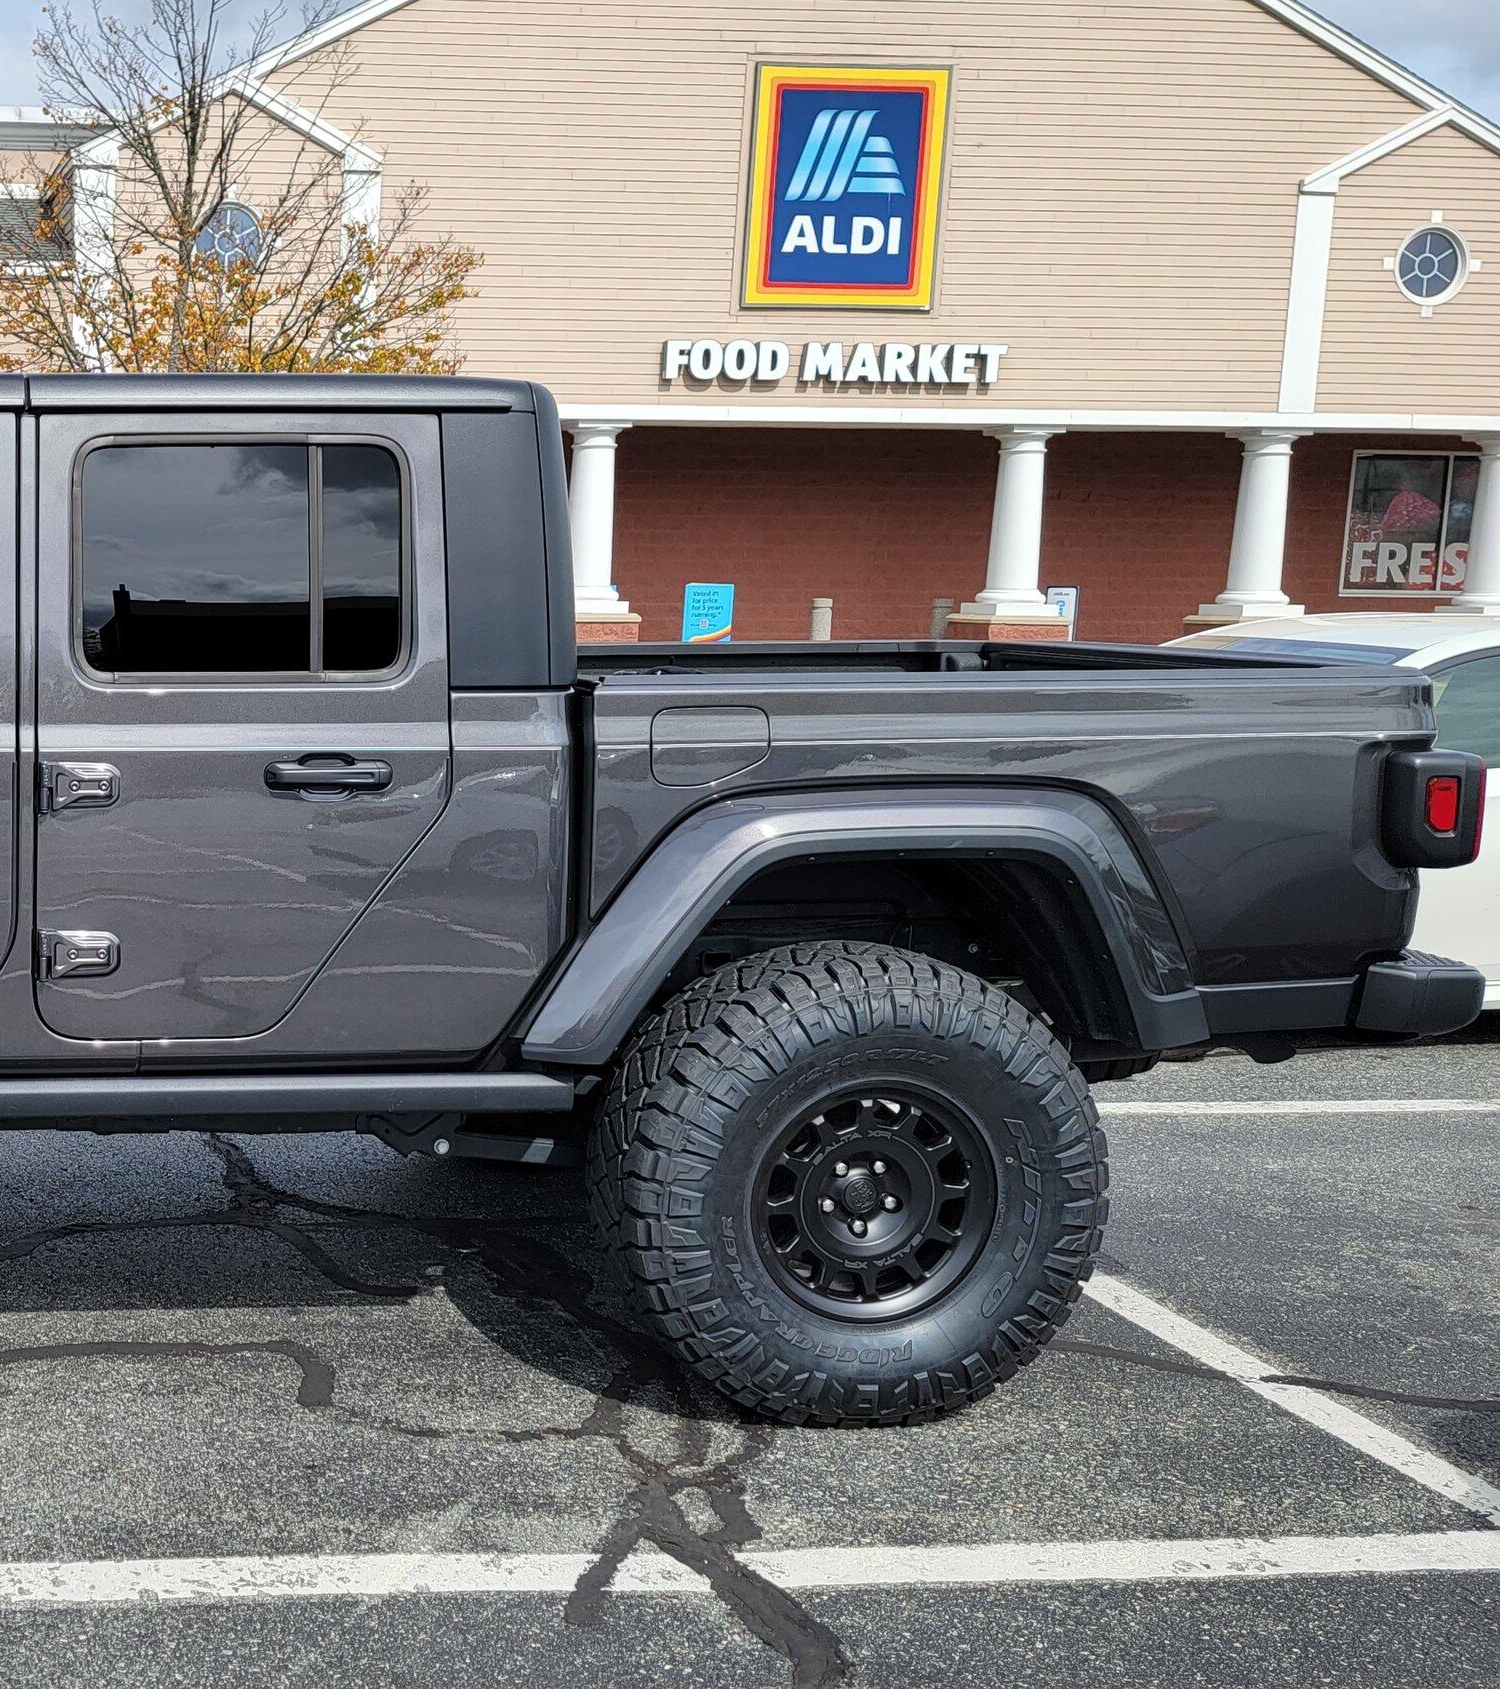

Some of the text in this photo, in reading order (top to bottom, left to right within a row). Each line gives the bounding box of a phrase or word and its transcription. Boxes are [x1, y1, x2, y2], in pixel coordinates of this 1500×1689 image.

[780, 215, 902, 255] ALDI
[662, 338, 1009, 384] FOOD MARKET
[702, 597, 719, 605] price
